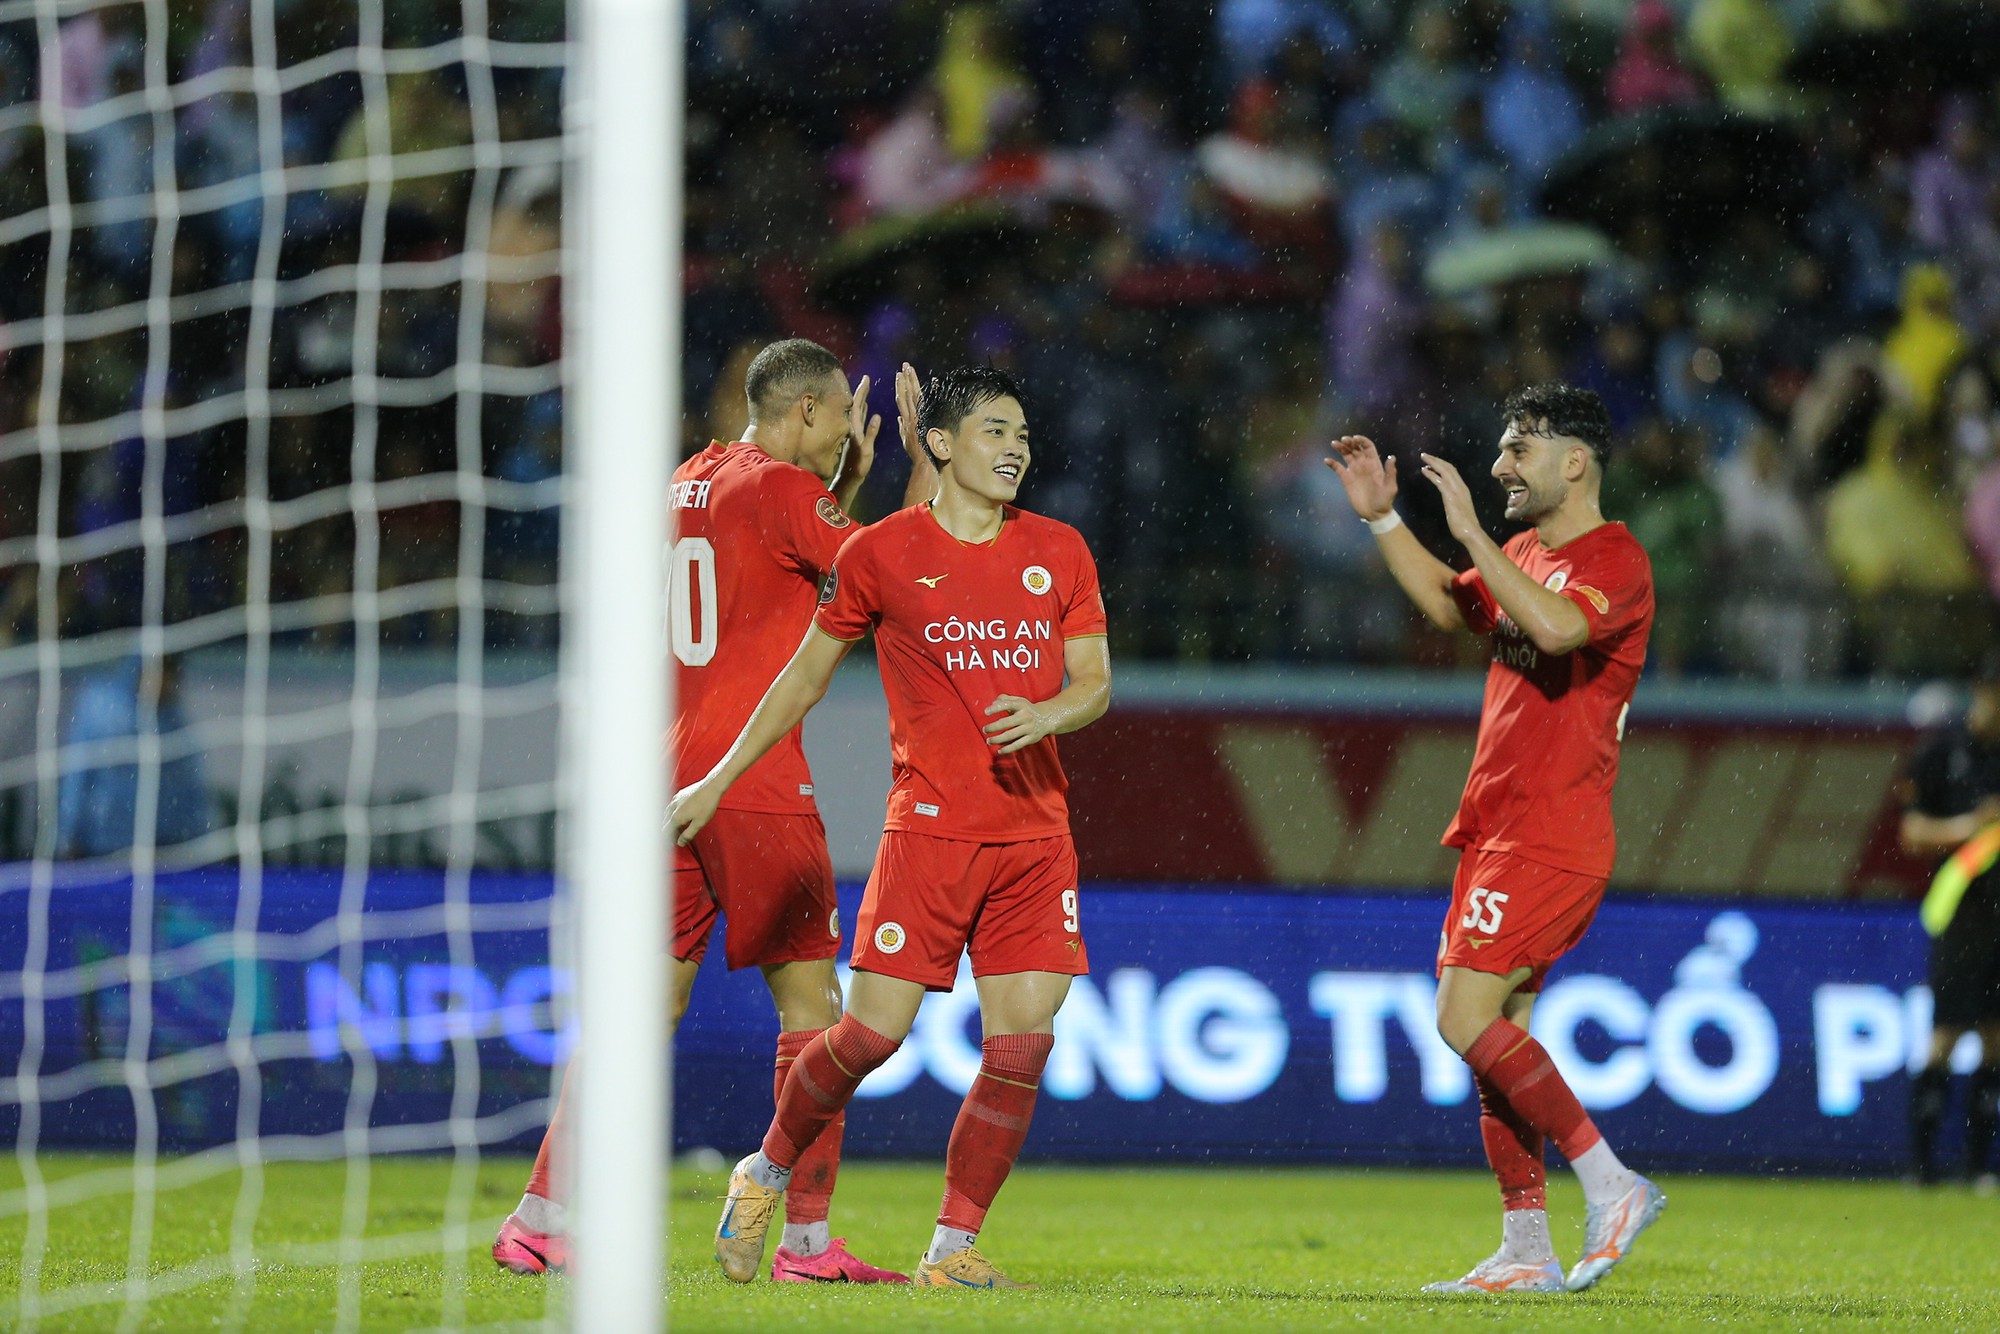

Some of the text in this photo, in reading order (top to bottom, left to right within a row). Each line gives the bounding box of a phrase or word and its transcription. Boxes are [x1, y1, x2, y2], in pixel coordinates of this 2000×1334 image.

[663, 537, 718, 666] 0
[923, 615, 1050, 643] CÔNG AN
[945, 643, 1039, 673] HÀ NỘI
[1061, 889, 1078, 933] 9
[1462, 887, 1509, 935] 55
[1308, 970, 1472, 1106] TY
